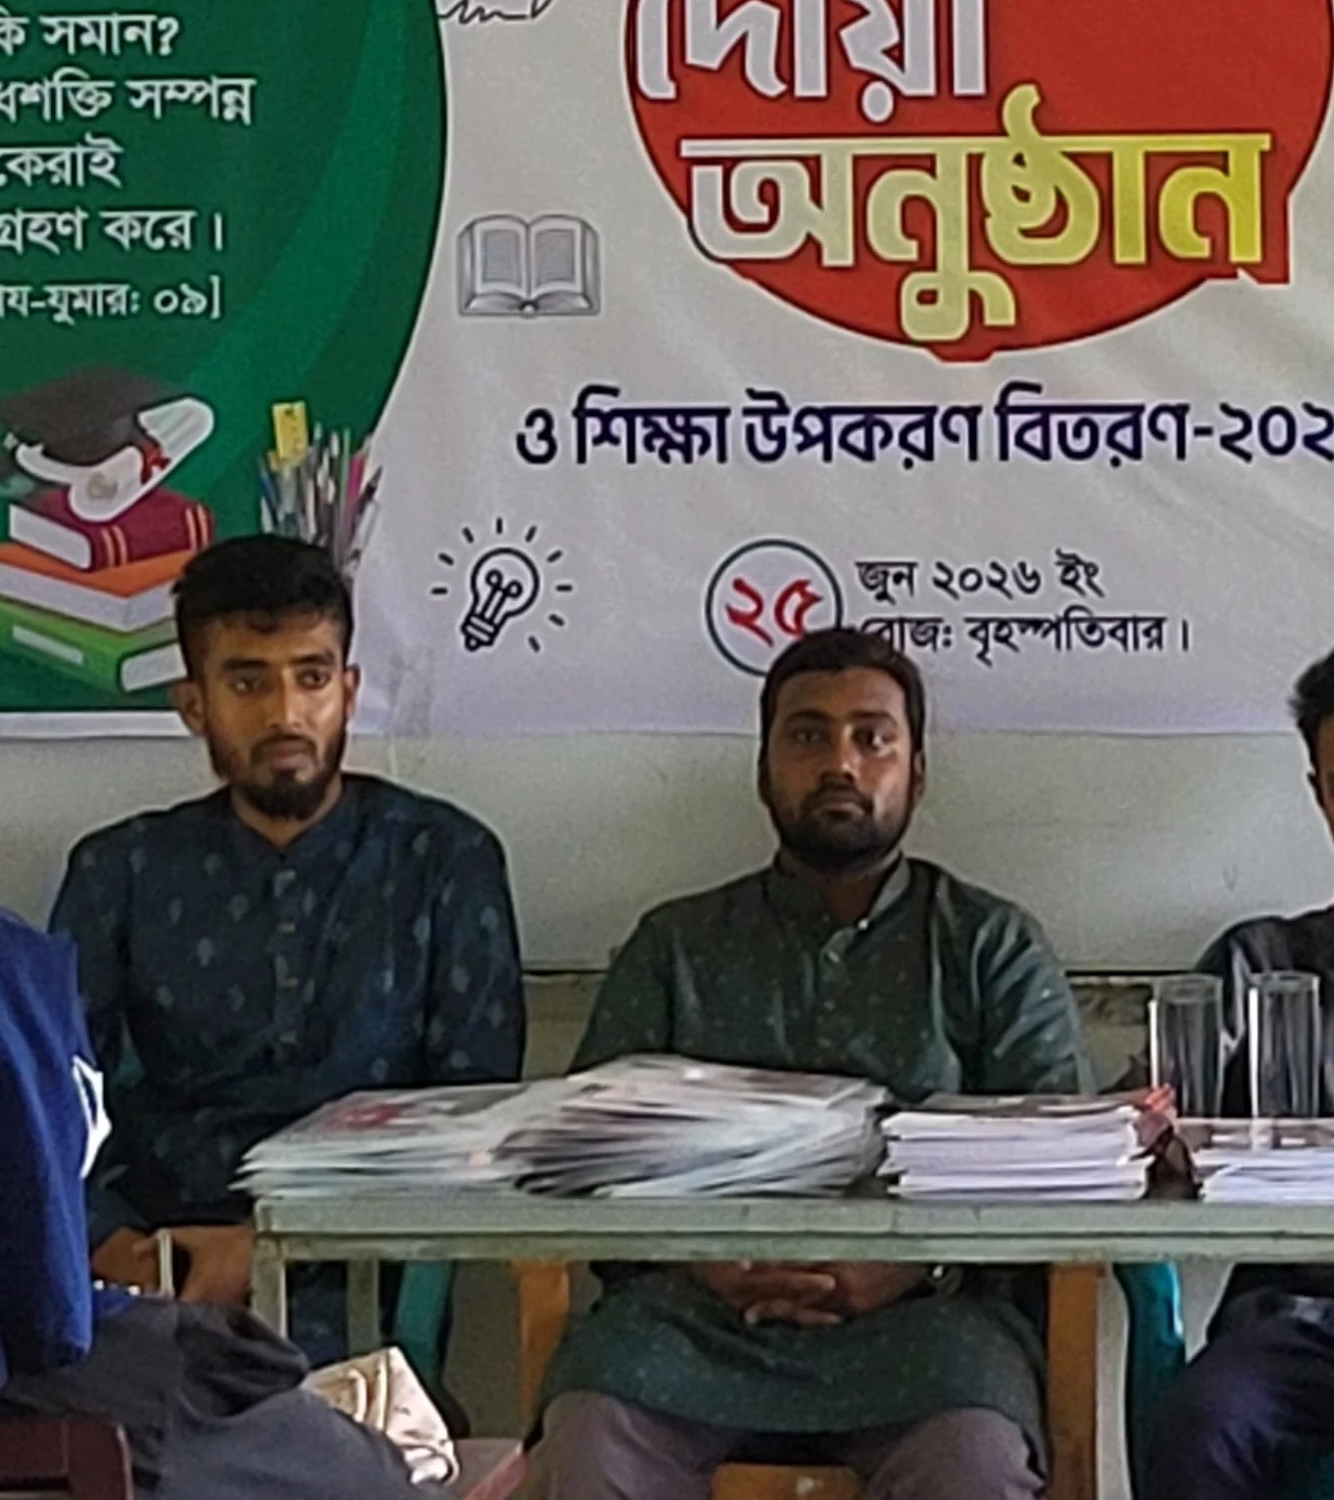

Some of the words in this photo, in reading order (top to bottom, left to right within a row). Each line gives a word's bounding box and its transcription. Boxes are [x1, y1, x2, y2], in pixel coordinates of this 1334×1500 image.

[42, 14, 179, 56] সমান?
[126, 76, 257, 125] সম্পন্ন
[101, 210, 197, 251] করে
[680, 83, 1271, 342] অনুষ্ঠান
[153, 275, 221, 319] ০৯]
[516, 407, 558, 466] ও
[571, 384, 732, 466] শিক্ষা
[741, 387, 983, 471] উপকরণ
[855, 561, 918, 605] জুন
[932, 560, 1042, 600] ২০২৬
[1054, 548, 1105, 598] ইং
[726, 578, 823, 648] ২৫
[964, 605, 1168, 668] বৃহস্পতিবার
